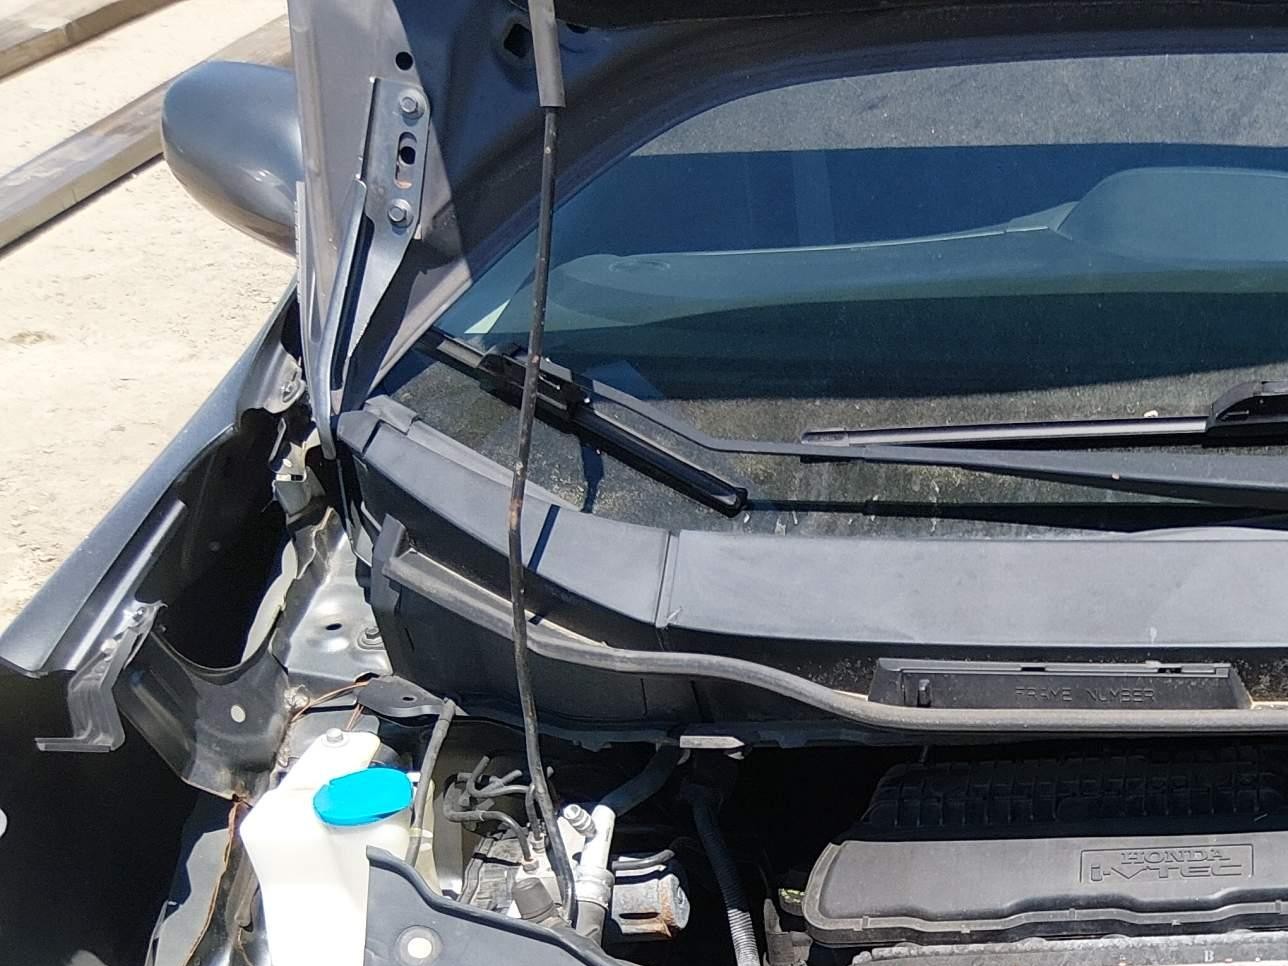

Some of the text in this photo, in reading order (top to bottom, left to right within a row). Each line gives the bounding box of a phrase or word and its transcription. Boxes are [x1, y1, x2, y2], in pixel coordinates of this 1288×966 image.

[1015, 686, 1156, 703] FRAME NUMBER
[1121, 849, 1231, 865] HONDA
[1090, 863, 1242, 882] i-VTEC
